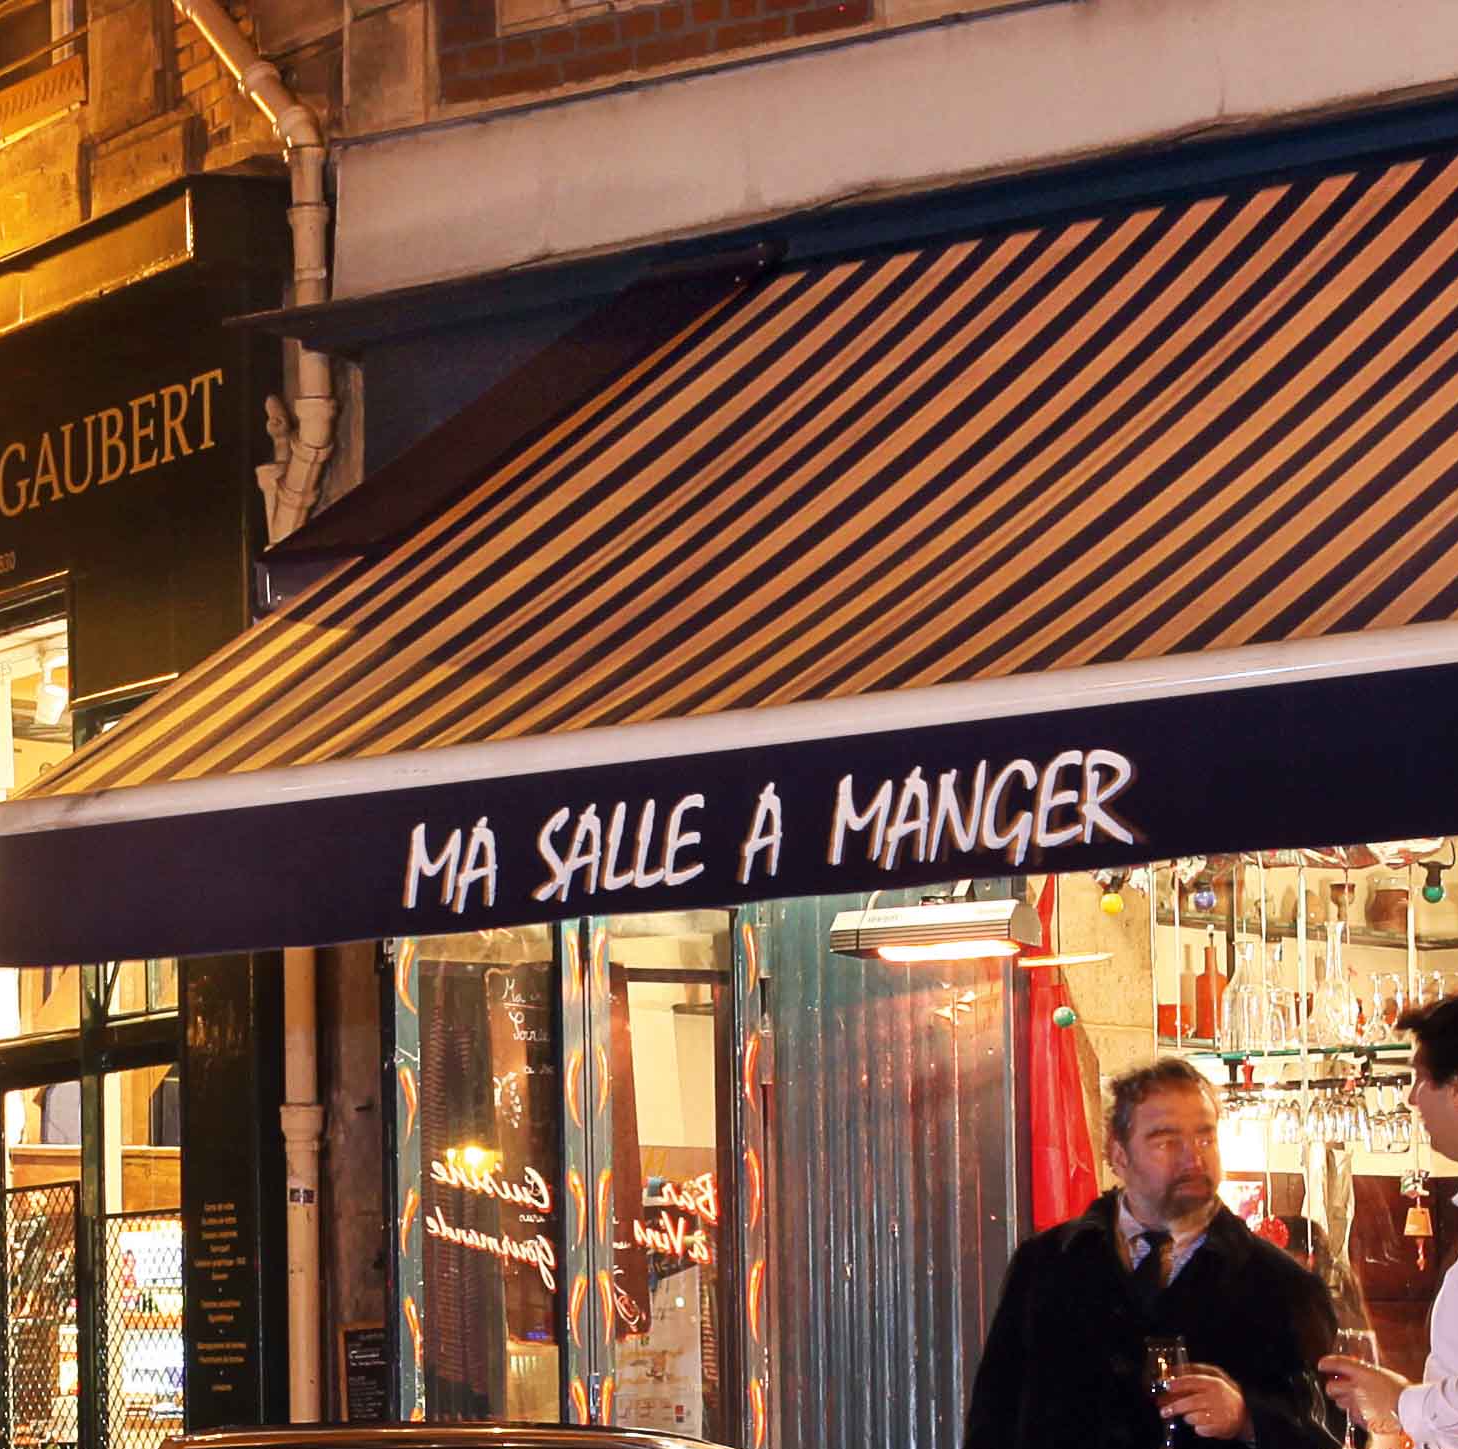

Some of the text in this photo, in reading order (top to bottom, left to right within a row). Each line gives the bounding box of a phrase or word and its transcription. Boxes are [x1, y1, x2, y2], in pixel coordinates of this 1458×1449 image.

[403, 816, 498, 914] MA
[533, 793, 705, 901] SALLE
[828, 749, 1136, 867] MANGER
